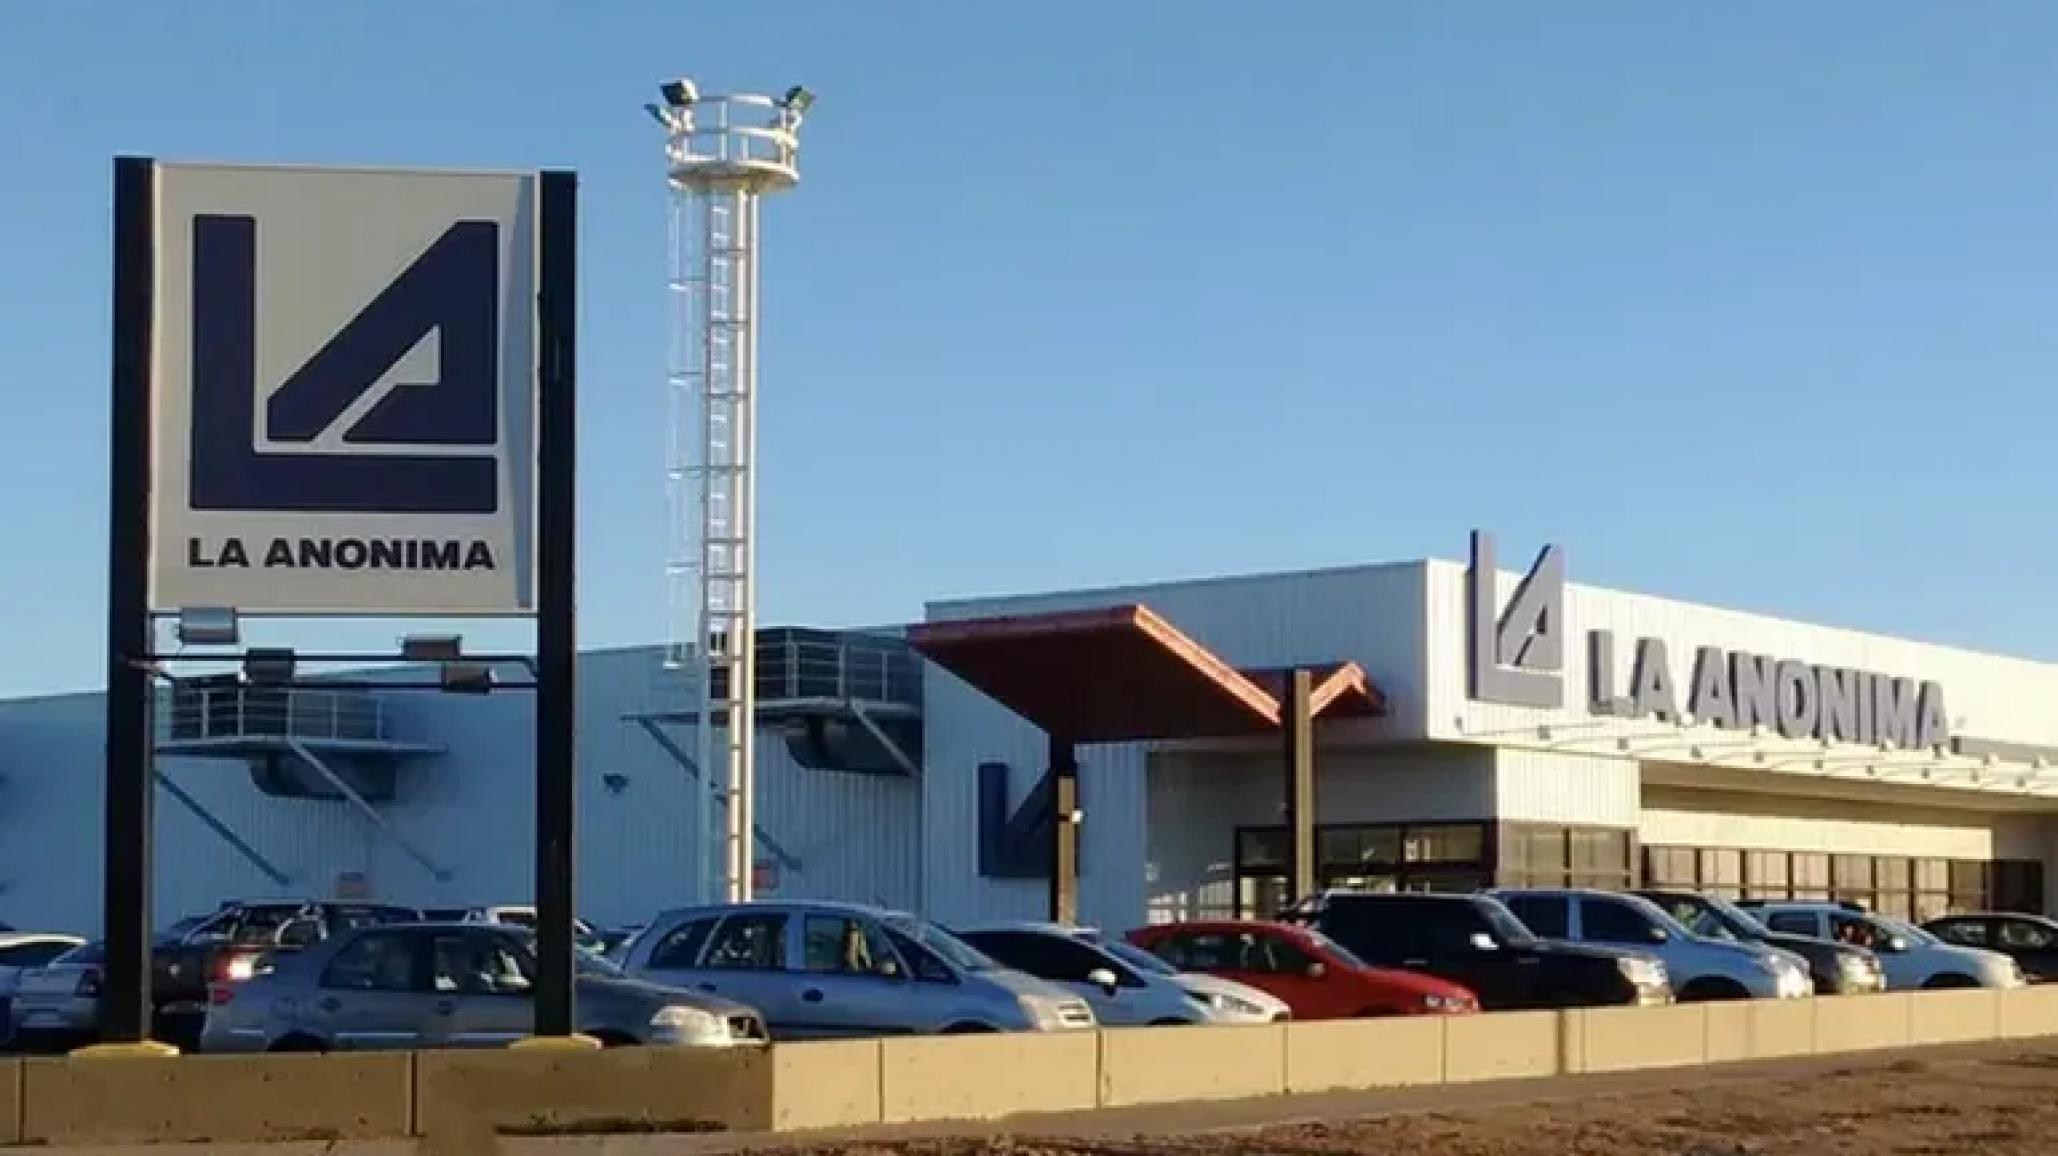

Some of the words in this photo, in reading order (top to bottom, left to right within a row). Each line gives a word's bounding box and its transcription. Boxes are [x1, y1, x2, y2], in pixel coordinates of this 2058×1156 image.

[190, 213, 498, 514] LA
[188, 537, 249, 569] LA
[264, 539, 497, 571] ANONIMA
[1468, 529, 1564, 709] LA
[1586, 630, 1678, 722] LA
[1688, 646, 1949, 751] ANONIMA
